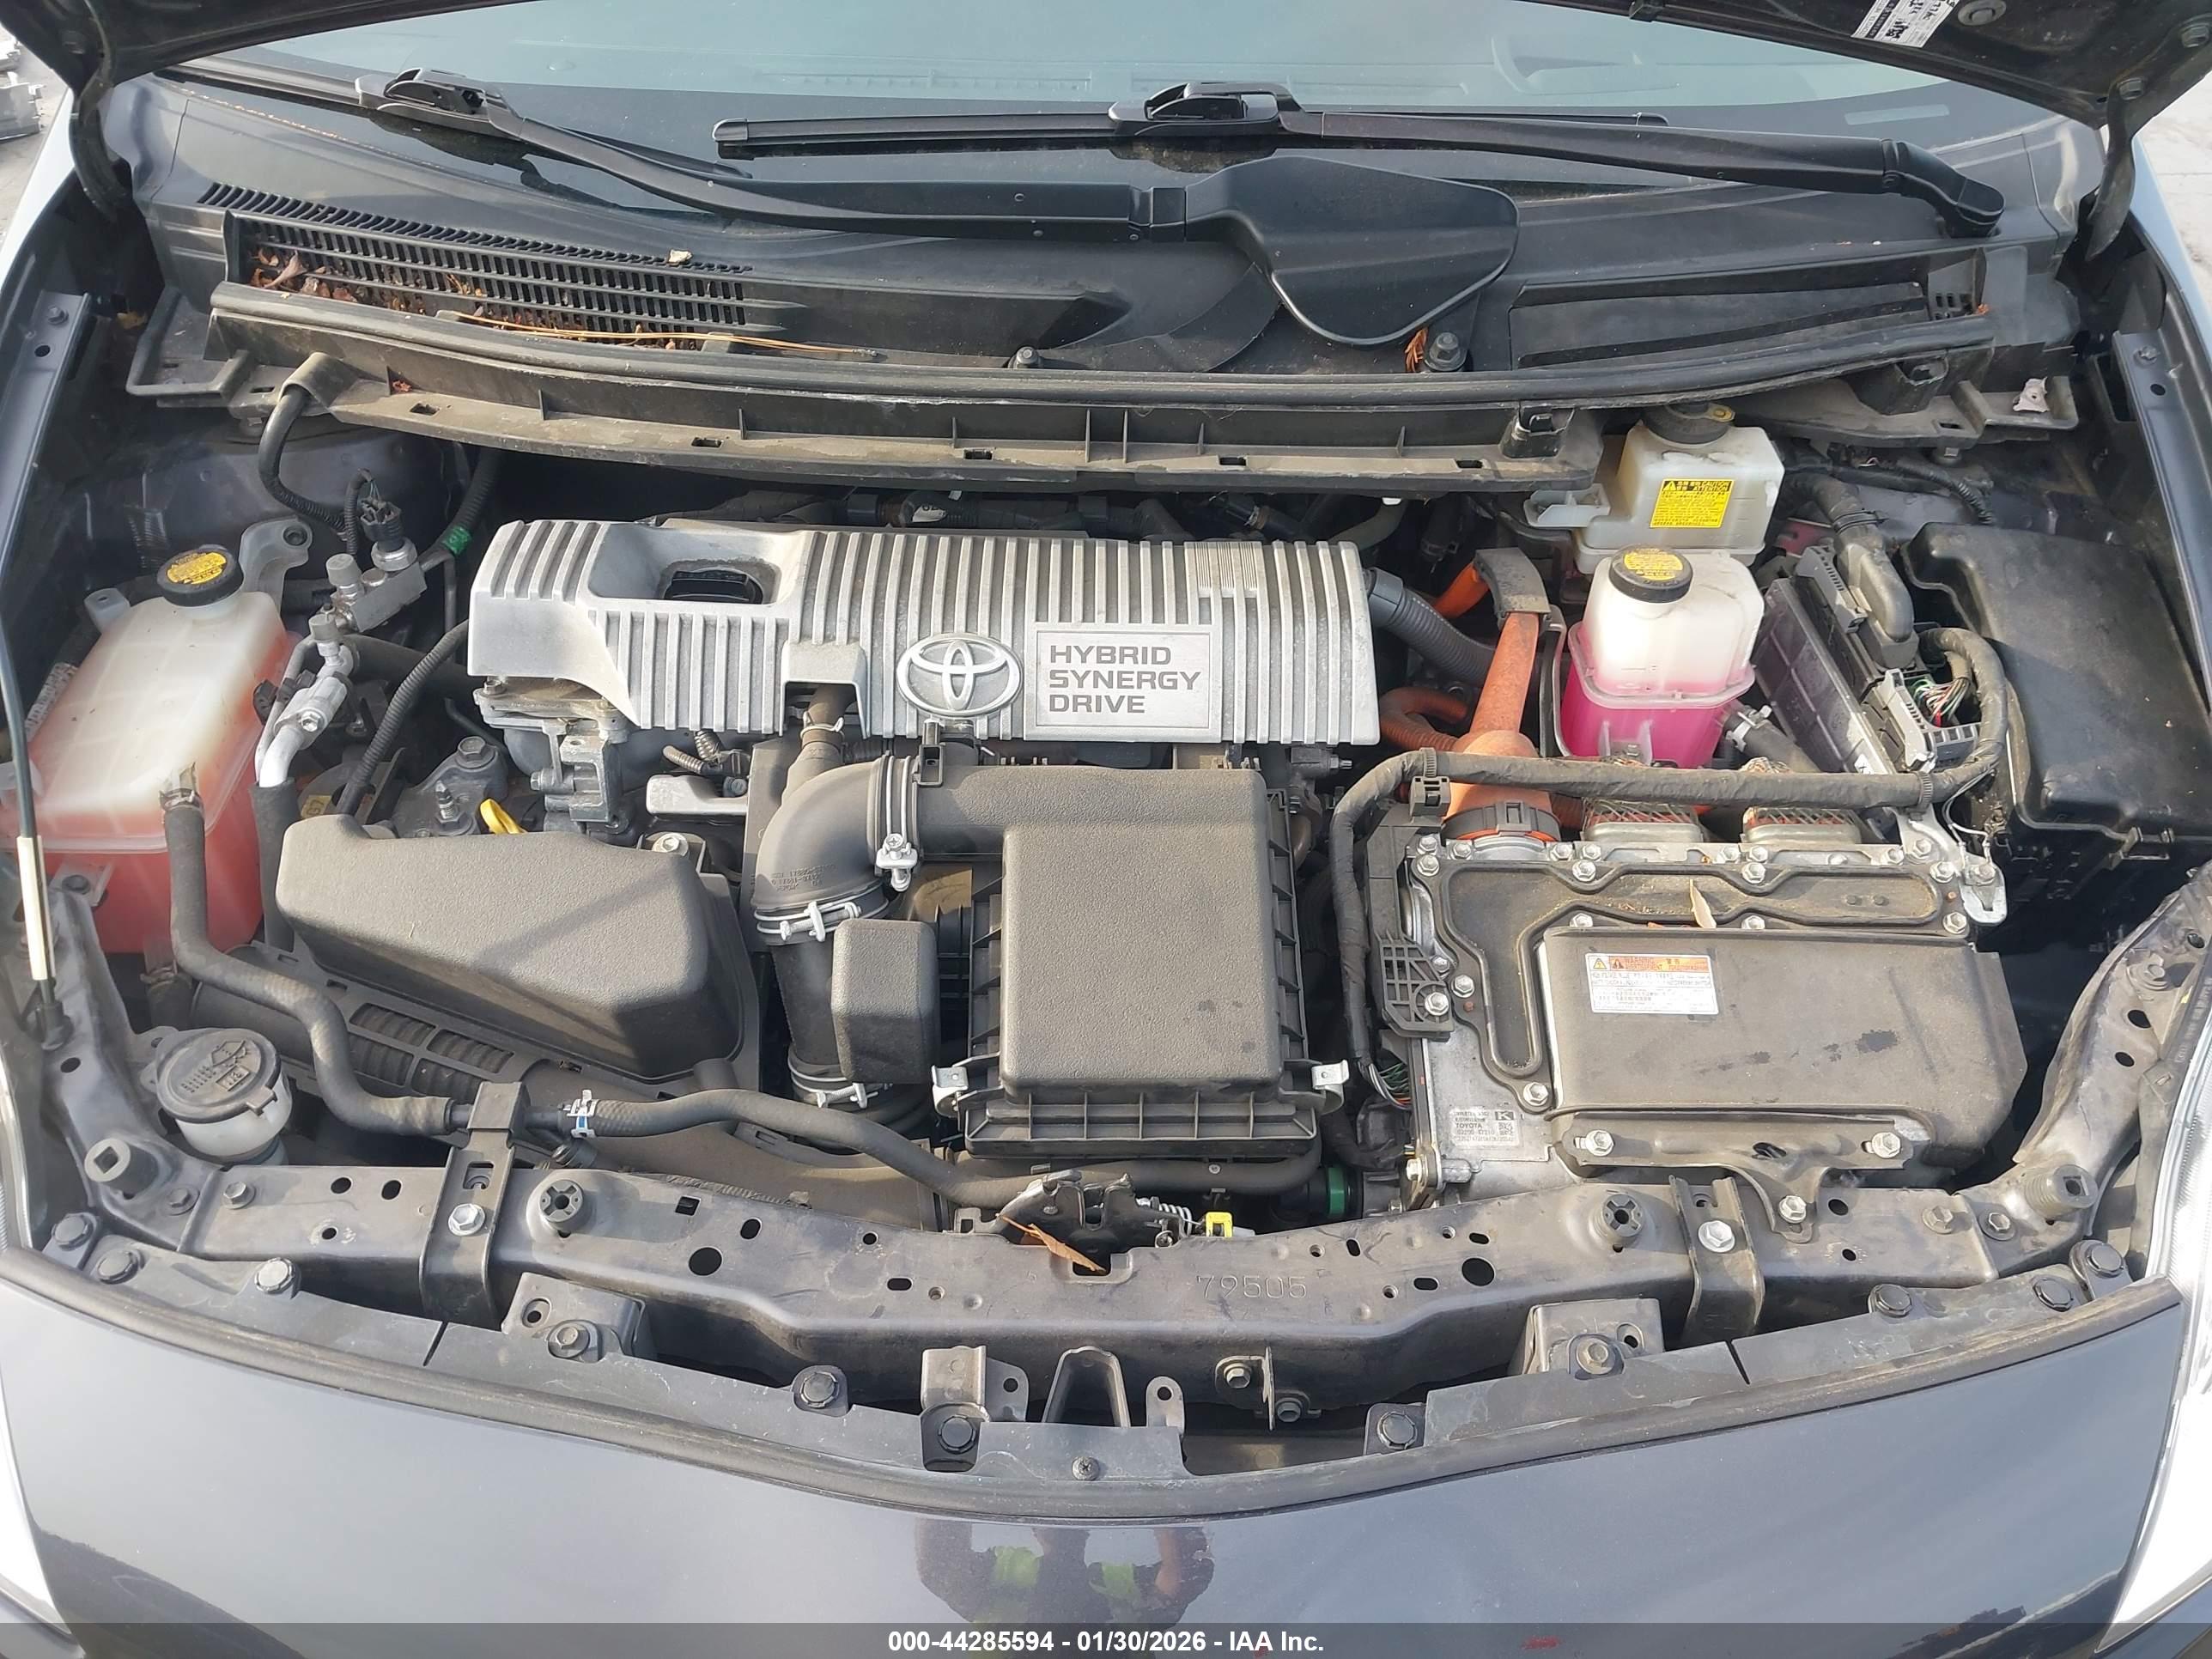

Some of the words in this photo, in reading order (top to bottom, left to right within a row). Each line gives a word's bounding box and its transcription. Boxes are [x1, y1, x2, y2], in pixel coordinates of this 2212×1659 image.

[1050, 645, 1171, 665] HYBRID
[1049, 670, 1200, 690] SYNERGY
[1049, 694, 1146, 714] DRIVE
[1196, 1275, 1307, 1299] 79505
